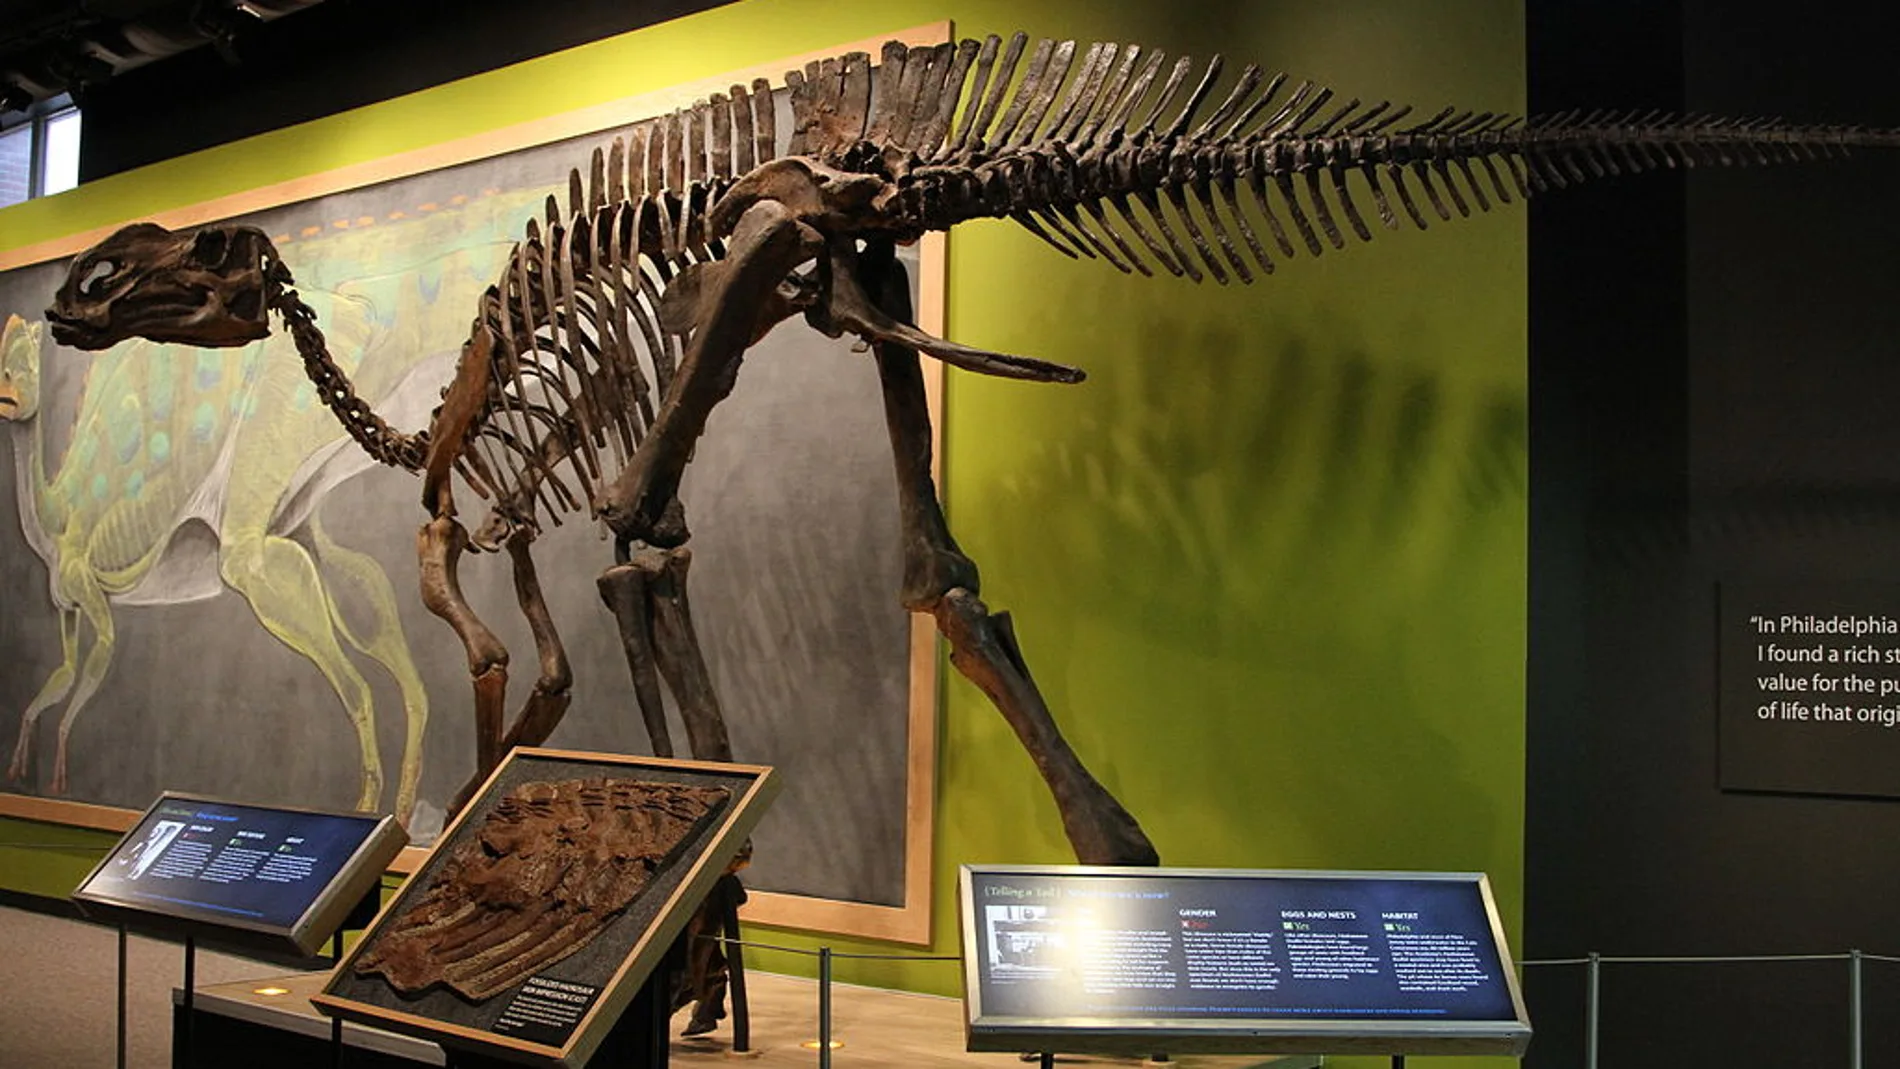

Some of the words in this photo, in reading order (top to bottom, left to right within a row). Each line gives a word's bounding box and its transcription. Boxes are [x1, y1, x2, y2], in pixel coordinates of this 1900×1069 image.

[1780, 616, 1898, 637] Philadelphia
[1758, 645, 1763, 662] I
[1768, 644, 1823, 662] found
[1828, 649, 1839, 663] a
[1844, 645, 1880, 663] rich
[1757, 673, 1808, 691] value
[1812, 673, 1839, 691] for
[1843, 674, 1875, 692] the
[1757, 701, 1778, 719] of
[1781, 702, 1809, 720] life
[1813, 703, 1852, 721] that
[1179, 909, 1218, 917] GENDER
[1281, 910, 1305, 918] EGGS
[1307, 911, 1327, 919] AND
[1328, 911, 1356, 919] NESTS
[1293, 922, 1310, 930] Yes
[1395, 923, 1411, 931] Yes
